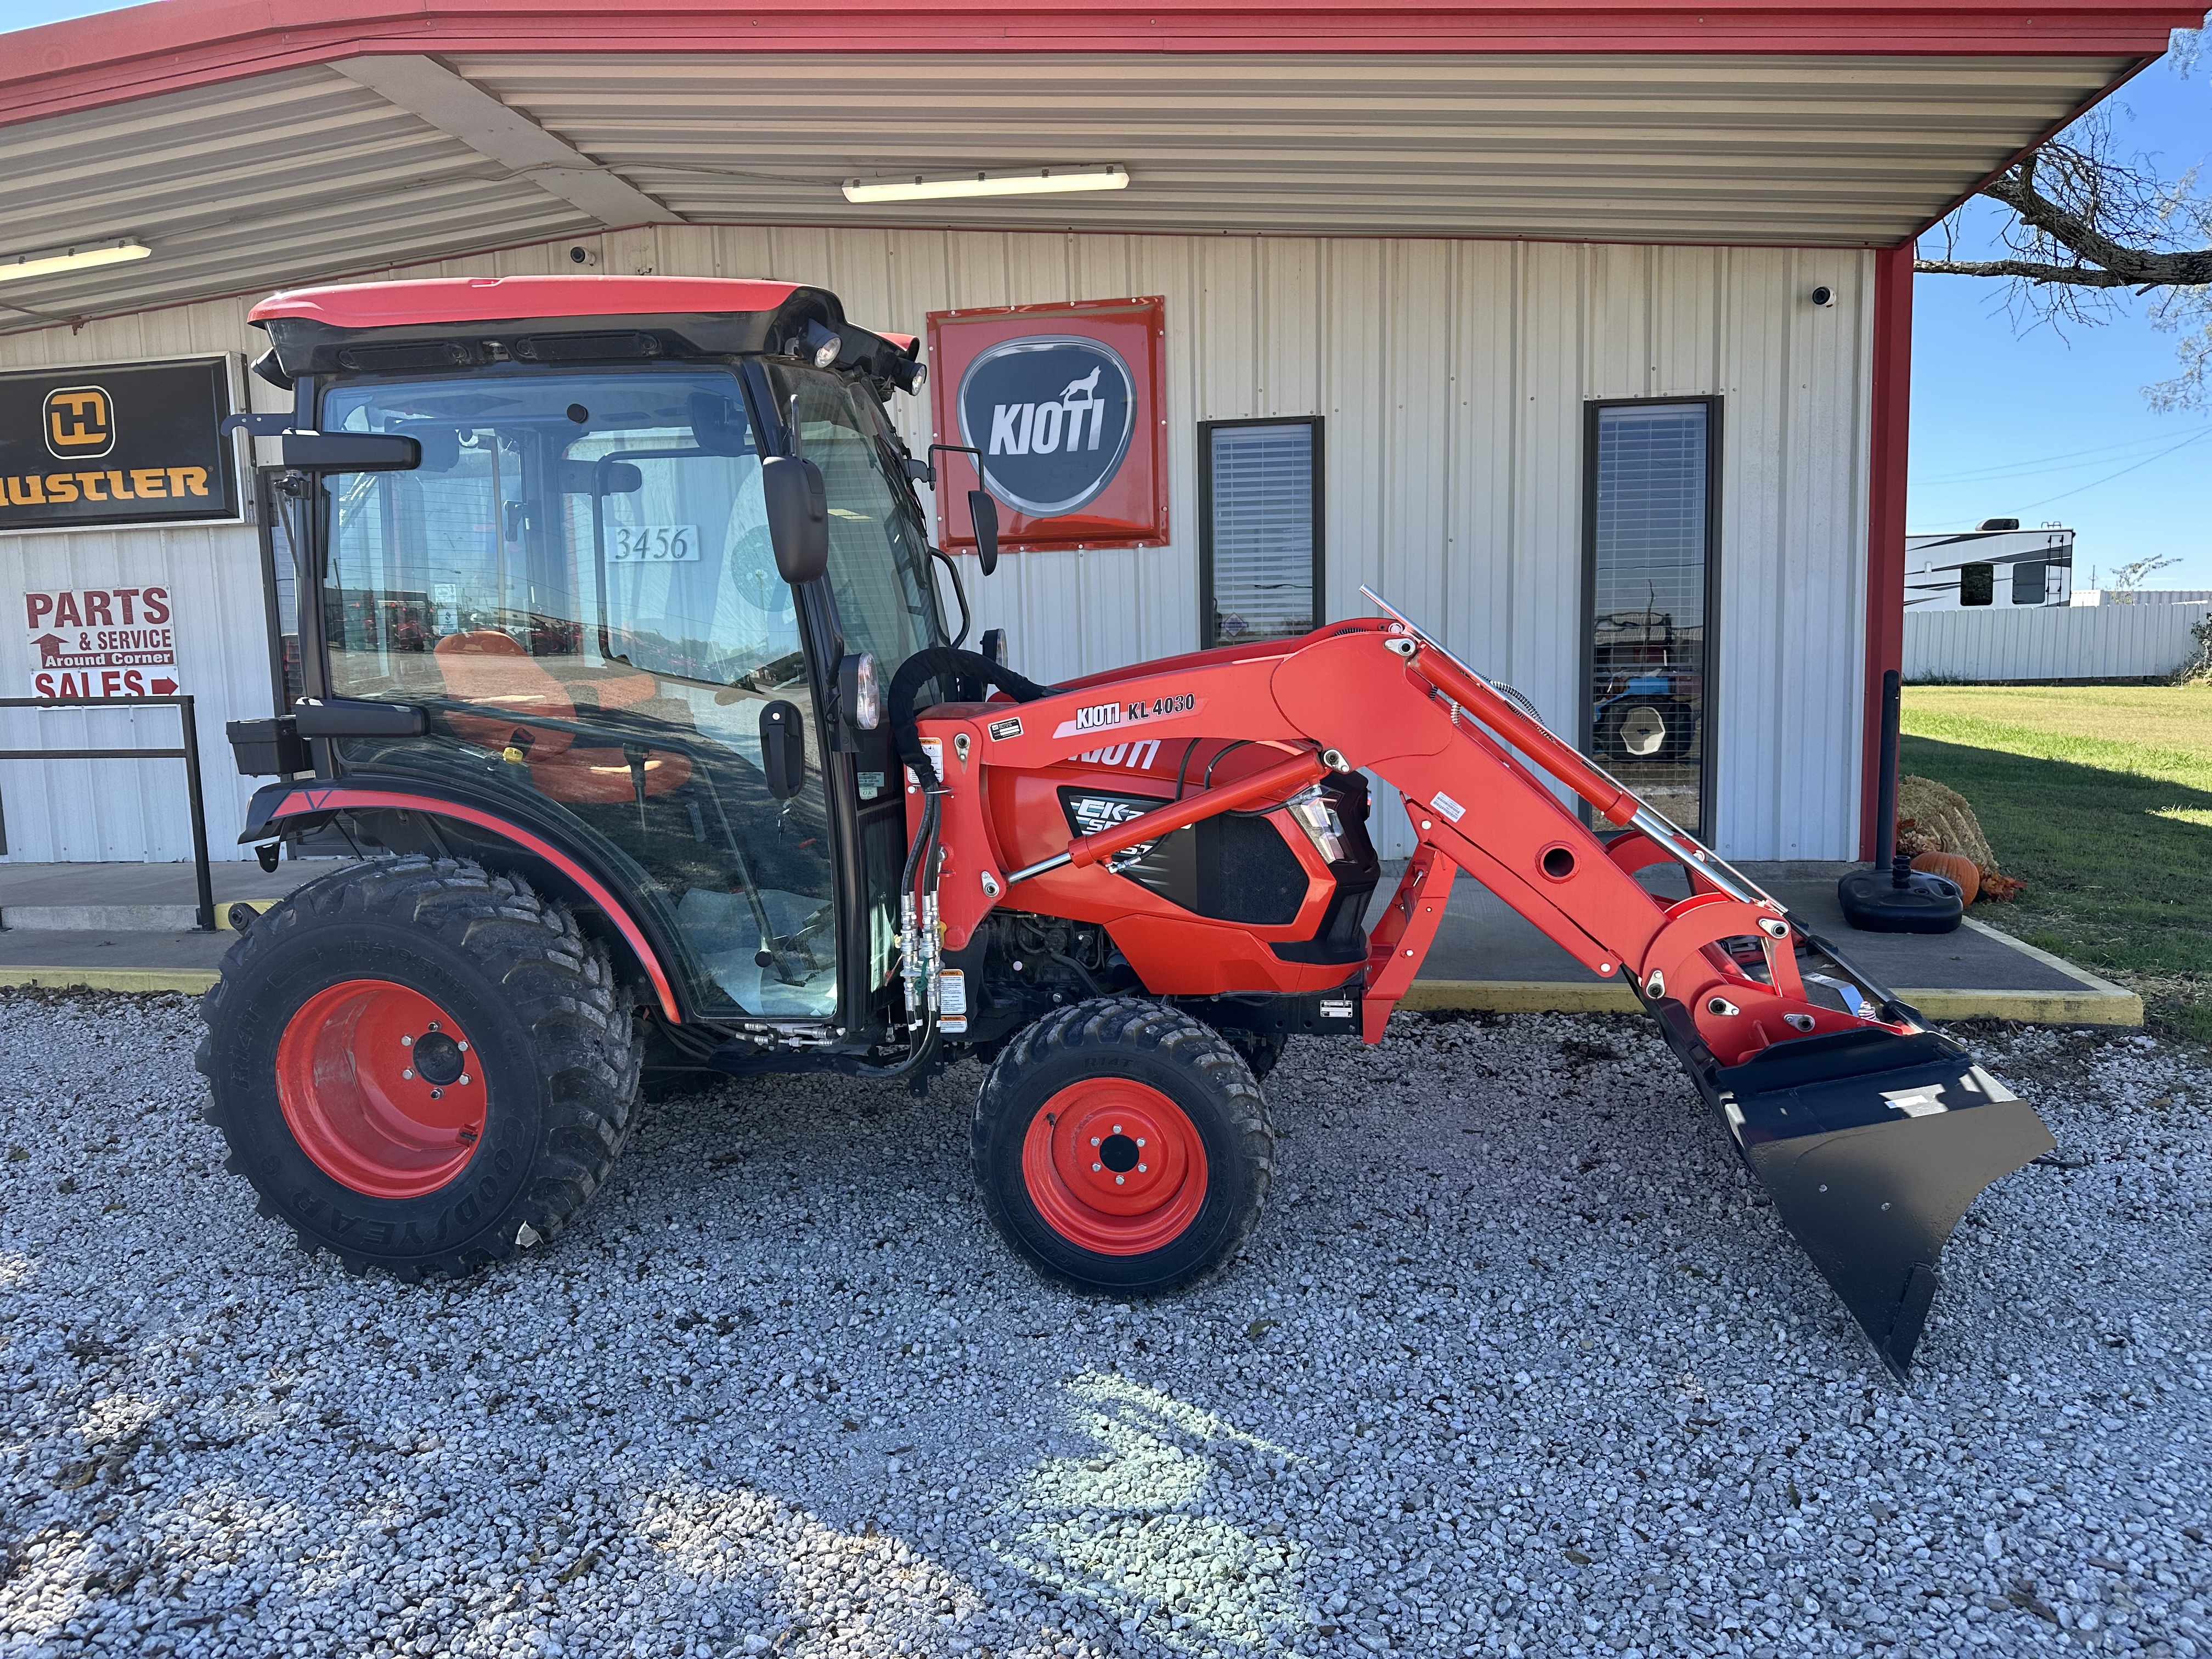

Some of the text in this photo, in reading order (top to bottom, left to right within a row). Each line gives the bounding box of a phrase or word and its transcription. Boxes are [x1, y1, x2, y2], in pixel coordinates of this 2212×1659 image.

[989, 398, 1105, 455] KIOTI
[615, 527, 688, 560] 3456
[26, 587, 170, 629] PARTS
[80, 629, 172, 651] & SERVICE
[45, 652, 170, 668] Around Corner
[1076, 693, 1195, 730] KIOTI KL 4030
